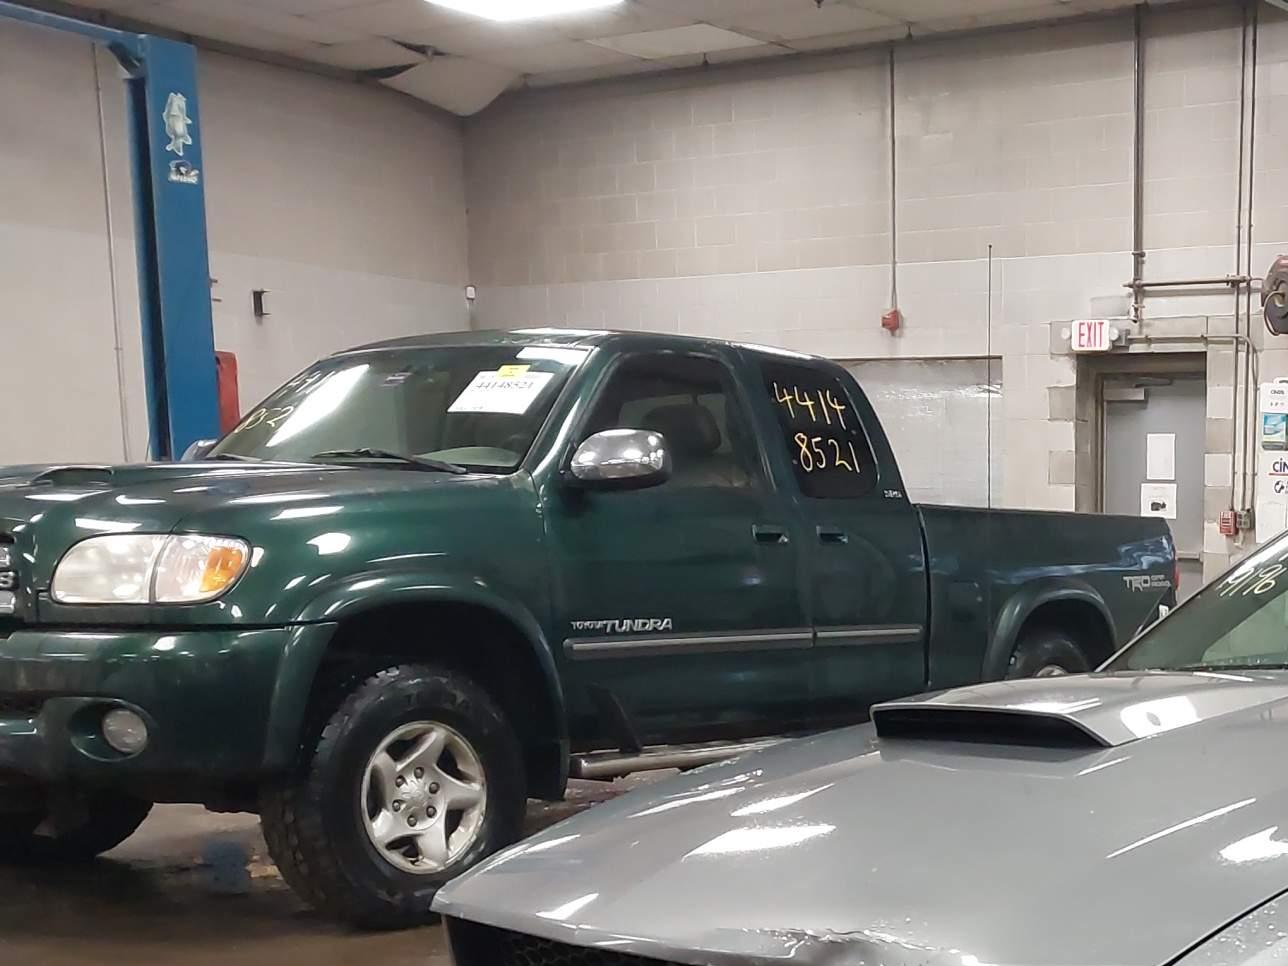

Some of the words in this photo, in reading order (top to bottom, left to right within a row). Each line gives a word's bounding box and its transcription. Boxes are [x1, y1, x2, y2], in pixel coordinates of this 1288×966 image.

[1078, 321, 1105, 348] EXIT
[773, 382, 847, 430] 4414
[794, 433, 860, 473] 8521
[603, 618, 673, 633] TUNDRA
